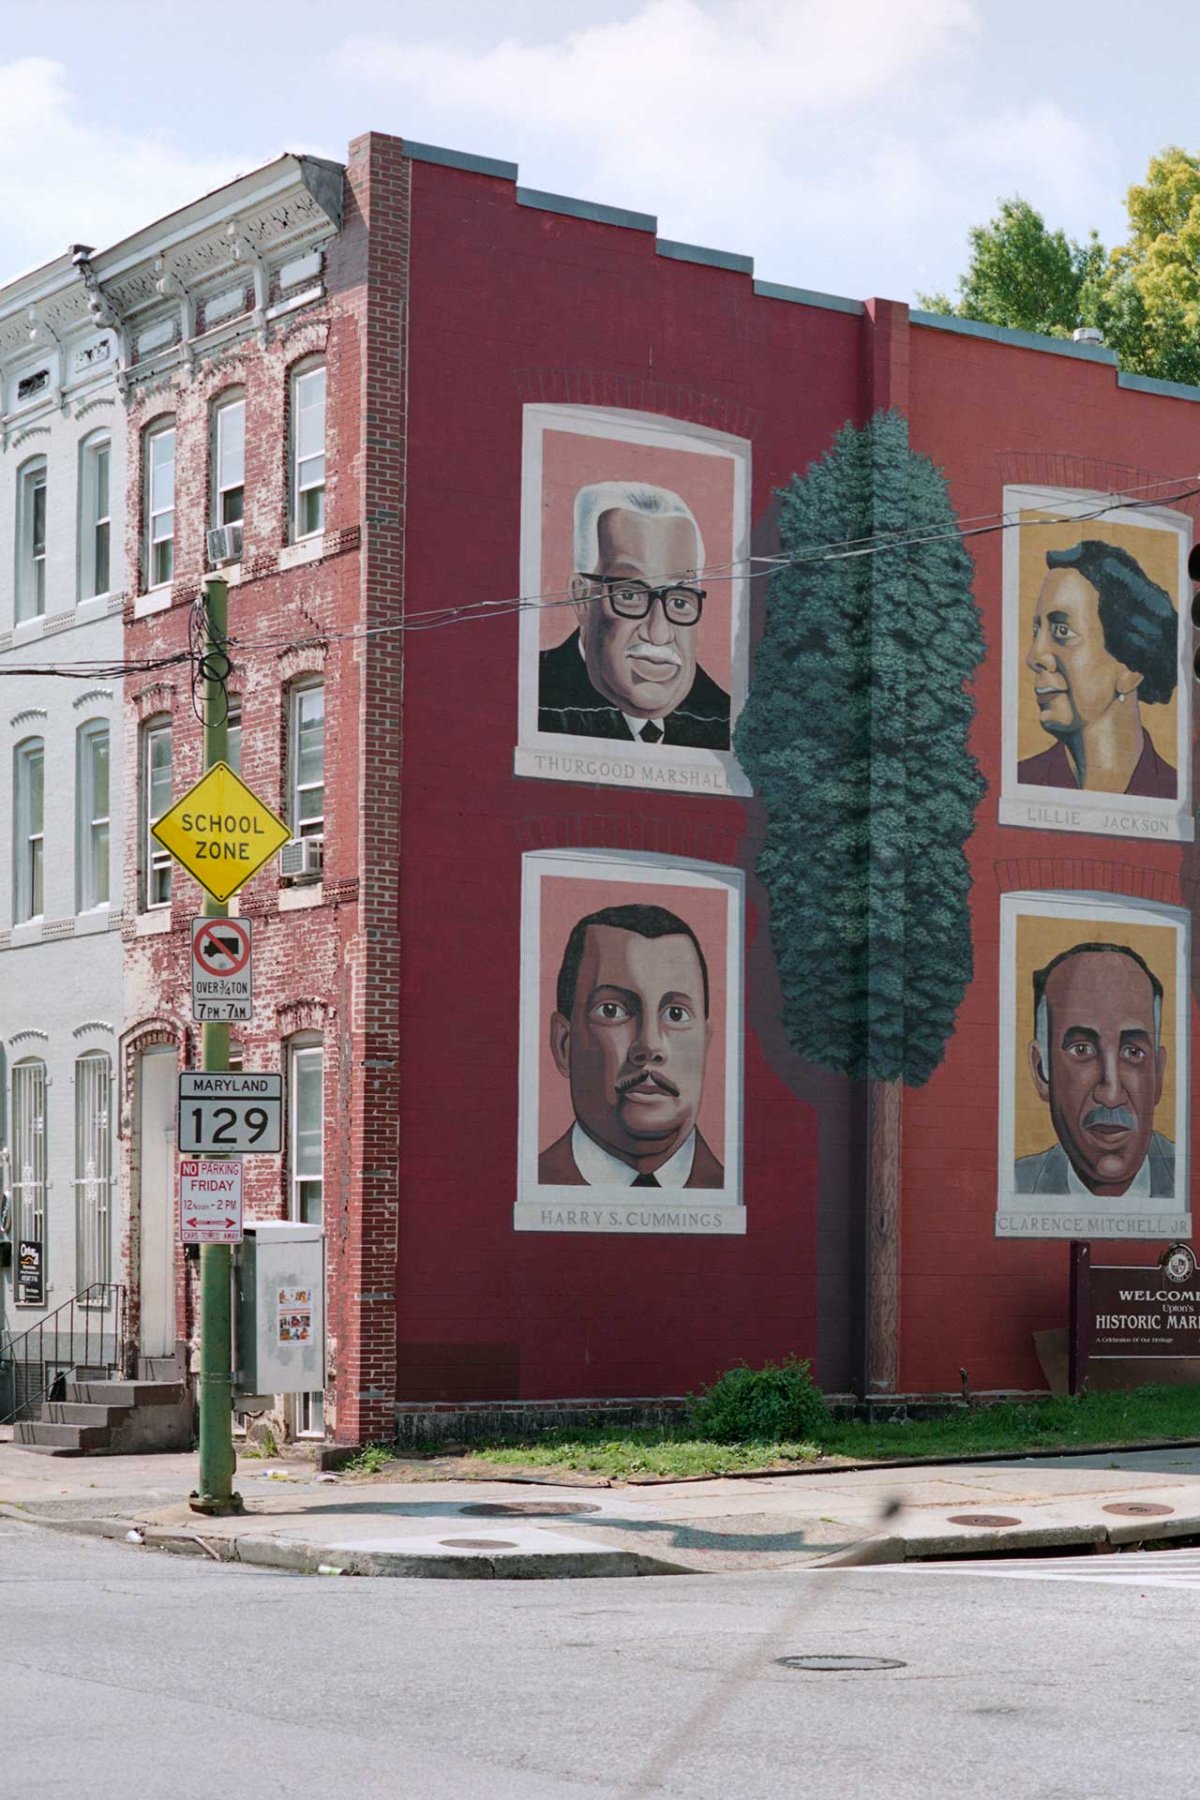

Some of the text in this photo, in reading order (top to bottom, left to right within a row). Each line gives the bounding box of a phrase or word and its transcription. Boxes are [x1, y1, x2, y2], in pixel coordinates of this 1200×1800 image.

[533, 755, 636, 779] THURGOOD
[181, 813, 265, 835] SCHOOL
[1027, 807, 1169, 834] LILLIE JACKSON
[195, 841, 250, 860] ZONE
[196, 981, 219, 994] OVER
[231, 982, 248, 994] TON
[193, 1079, 269, 1092] MARYLAND
[192, 1107, 269, 1145] 129
[182, 1162, 240, 1176] NO PARKING
[190, 1179, 235, 1192] FRIDAY
[540, 1210, 723, 1228] HARRY S. CUMMINGS
[998, 1216, 1083, 1233] CLARENCE
[1087, 1218, 1167, 1234] MITCHELL
[1162, 1304, 1194, 1314] Upton's
[1095, 1314, 1161, 1330] HISTORIC
